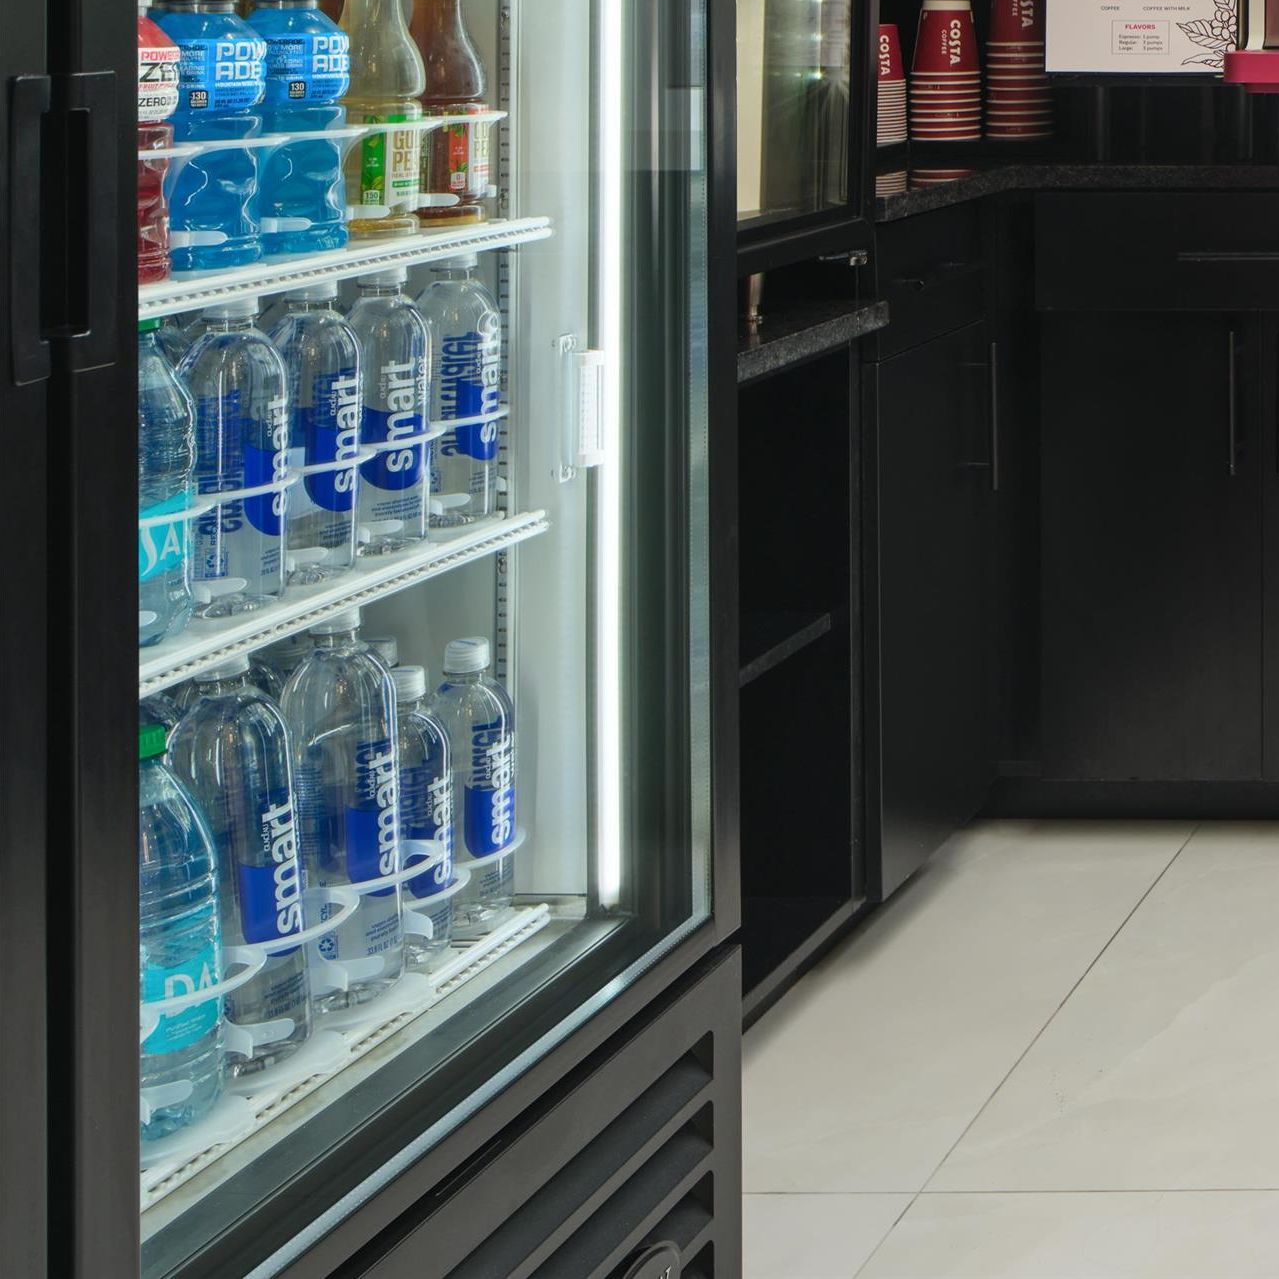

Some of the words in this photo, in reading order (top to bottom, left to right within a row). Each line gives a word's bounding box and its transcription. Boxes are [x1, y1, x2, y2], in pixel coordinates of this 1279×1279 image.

[879, 34, 891, 76] COSTA
[949, 19, 961, 65] COSTA
[191, 91, 206, 100] 130
[290, 83, 305, 91] 130
[365, 191, 379, 199] 150
[331, 374, 359, 493] smart
[381, 357, 415, 473] smart
[369, 751, 399, 876] smart
[486, 733, 511, 846] smart
[262, 795, 301, 935] smart
